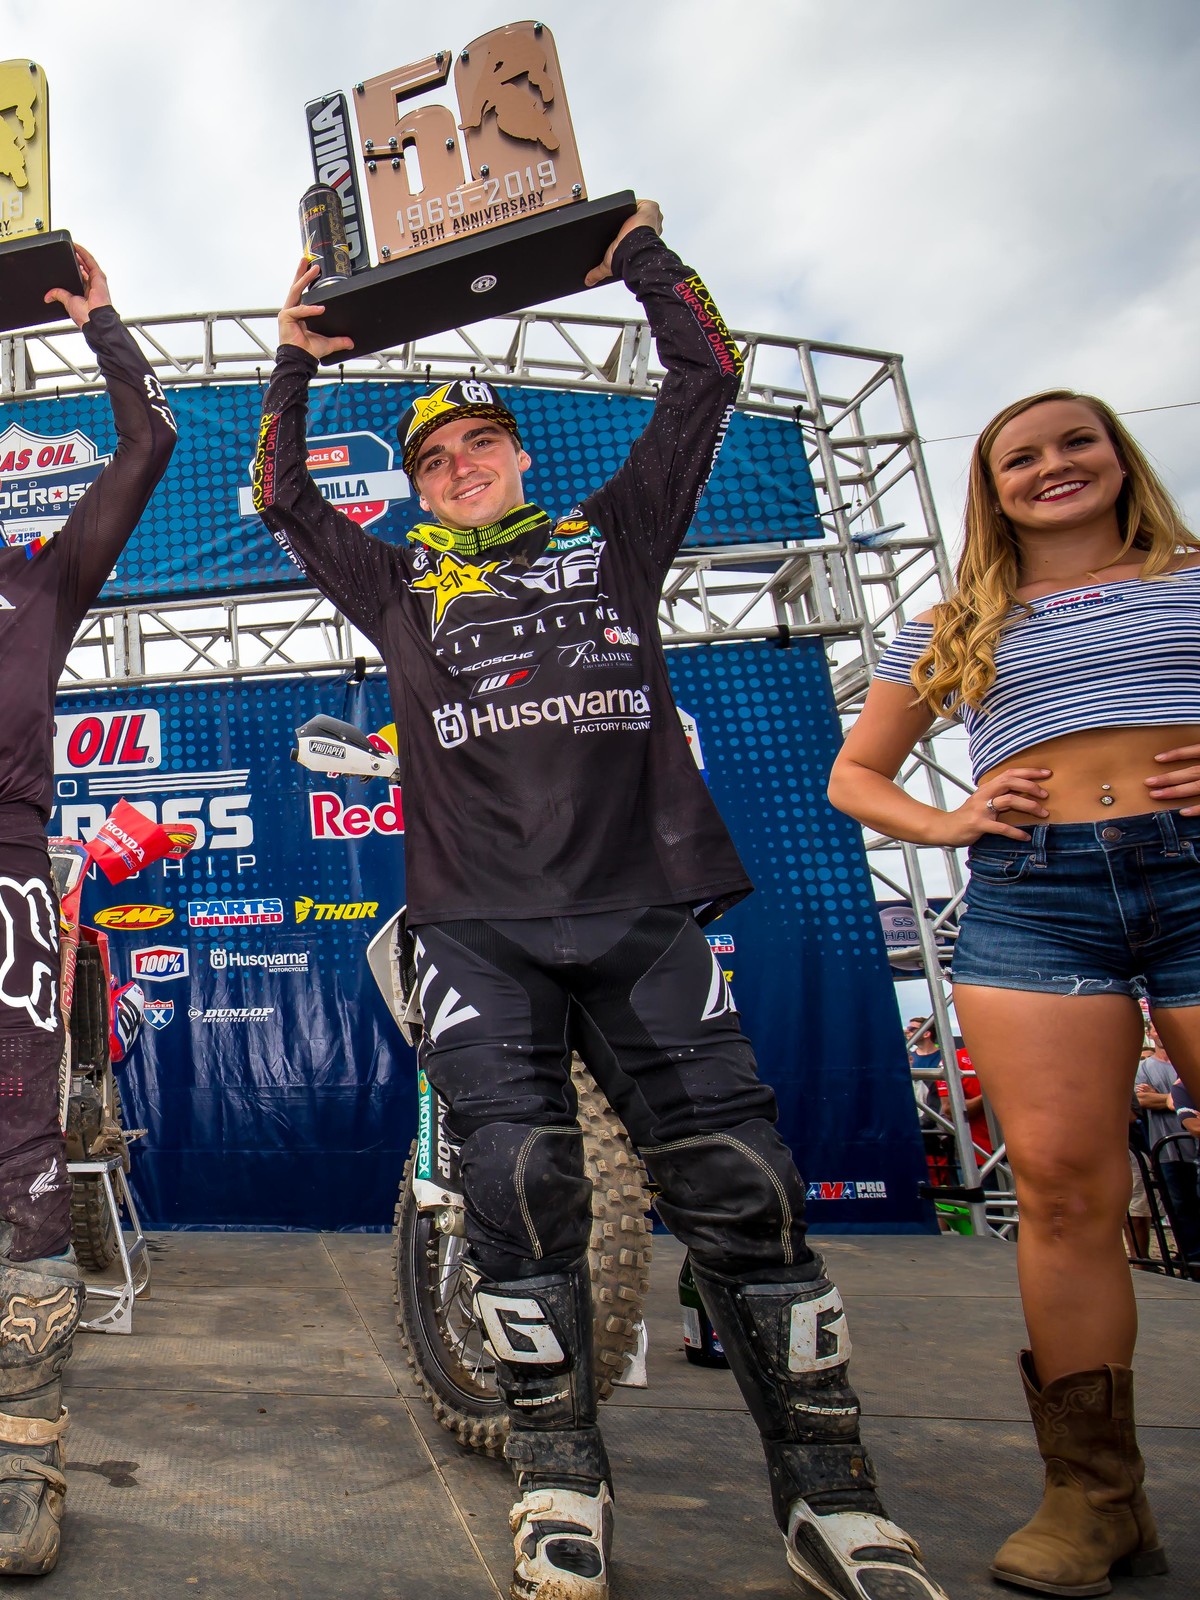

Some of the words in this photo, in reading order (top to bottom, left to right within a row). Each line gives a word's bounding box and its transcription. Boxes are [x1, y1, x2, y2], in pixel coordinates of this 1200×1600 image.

[395, 159, 559, 235] 1969-2019
[412, 224, 446, 244] 50TH
[451, 190, 546, 232] ANNIVERSARY
[674, 282, 715, 329] ENERGY
[708, 332, 735, 375] DRINK
[265, 414, 281, 450] DRINK
[37, 443, 76, 467] OIL
[263, 455, 275, 506] ENERGY
[513, 607, 619, 636] RACING
[461, 651, 534, 672] SCOSCHE
[478, 670, 529, 693] WP
[471, 687, 651, 737] Husqvarna
[573, 723, 620, 734] FACTORY
[67, 714, 150, 768] OIL
[310, 785, 405, 840] Red
[104, 817, 146, 863] HONDA
[96, 906, 174, 926] FMF
[189, 900, 282, 917] PARTS
[190, 914, 283, 926] UNLIMITED
[314, 902, 379, 920] THOR
[138, 953, 182, 973] 100%
[229, 952, 308, 968] Husqvarna
[151, 1009, 167, 1024] X
[203, 1007, 274, 1018] DUNLOP
[420, 1095, 430, 1176] MOTOREX
[806, 1182, 857, 1200] AMA
[856, 1181, 886, 1193] PRO
